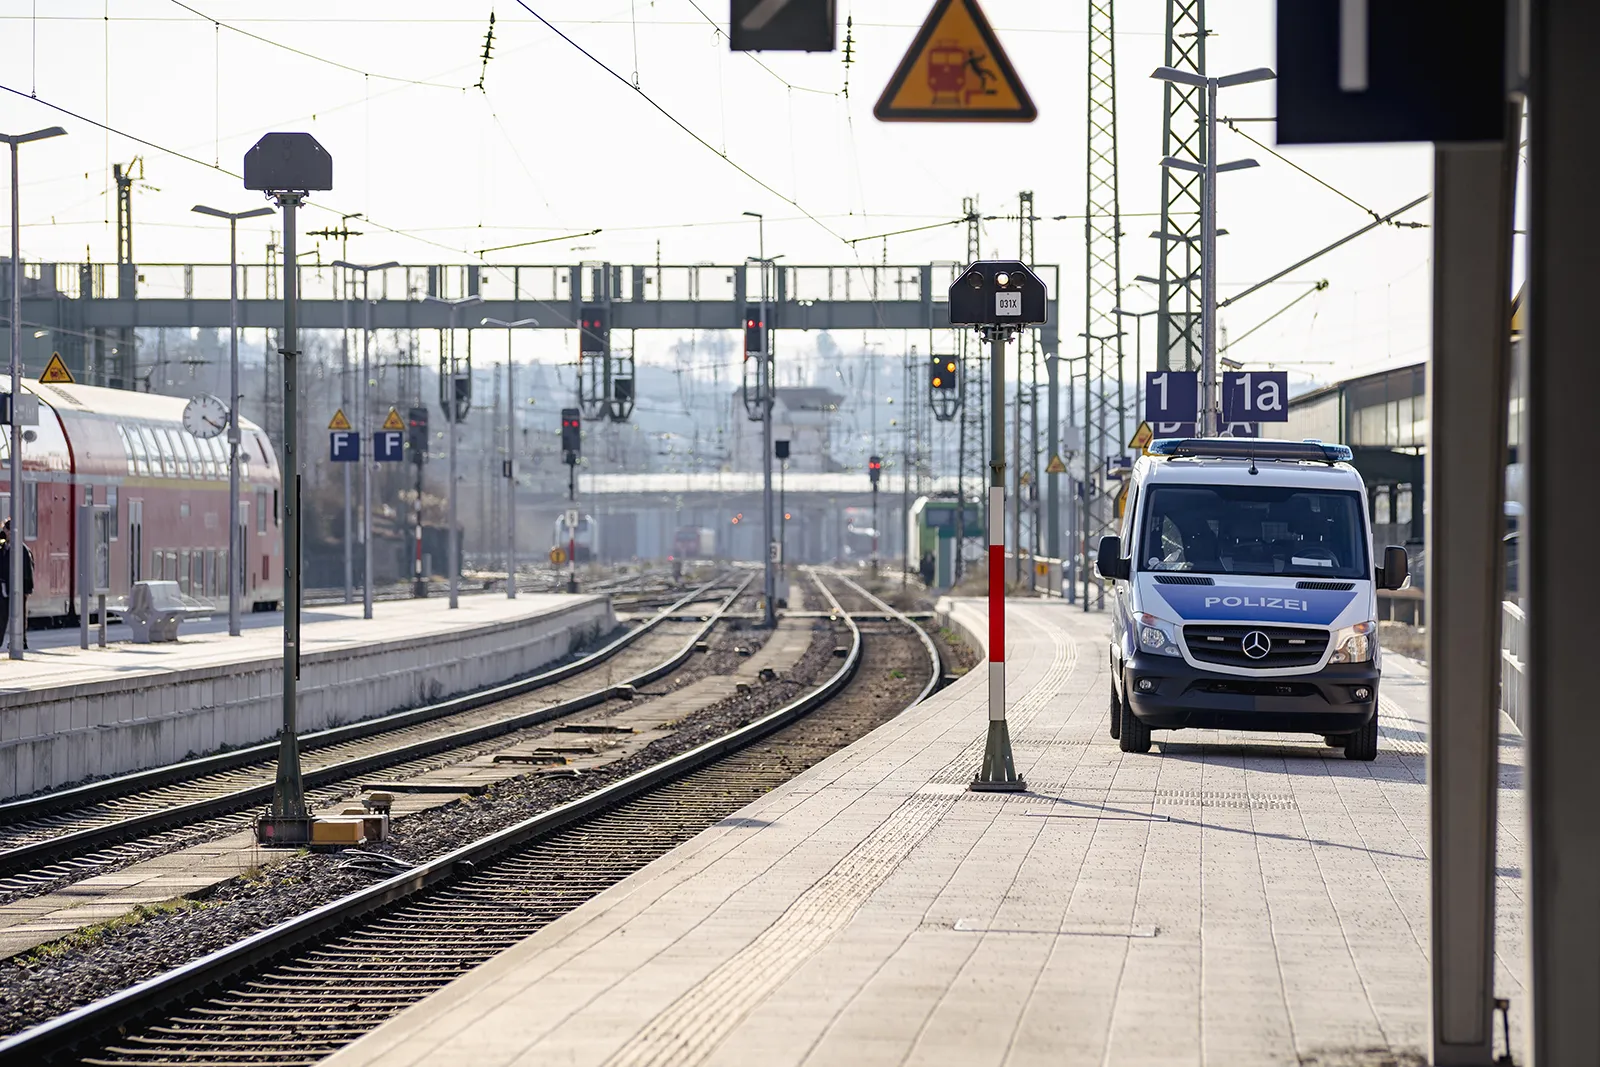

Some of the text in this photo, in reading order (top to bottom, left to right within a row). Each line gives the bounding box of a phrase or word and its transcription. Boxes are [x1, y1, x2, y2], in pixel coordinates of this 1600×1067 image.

[1000, 299, 1017, 308] 031X
[1152, 373, 1168, 411] 1
[1236, 373, 1282, 411] 1a
[334, 433, 348, 455] F
[385, 433, 399, 455] F
[1205, 596, 1308, 611] POLIZEI
